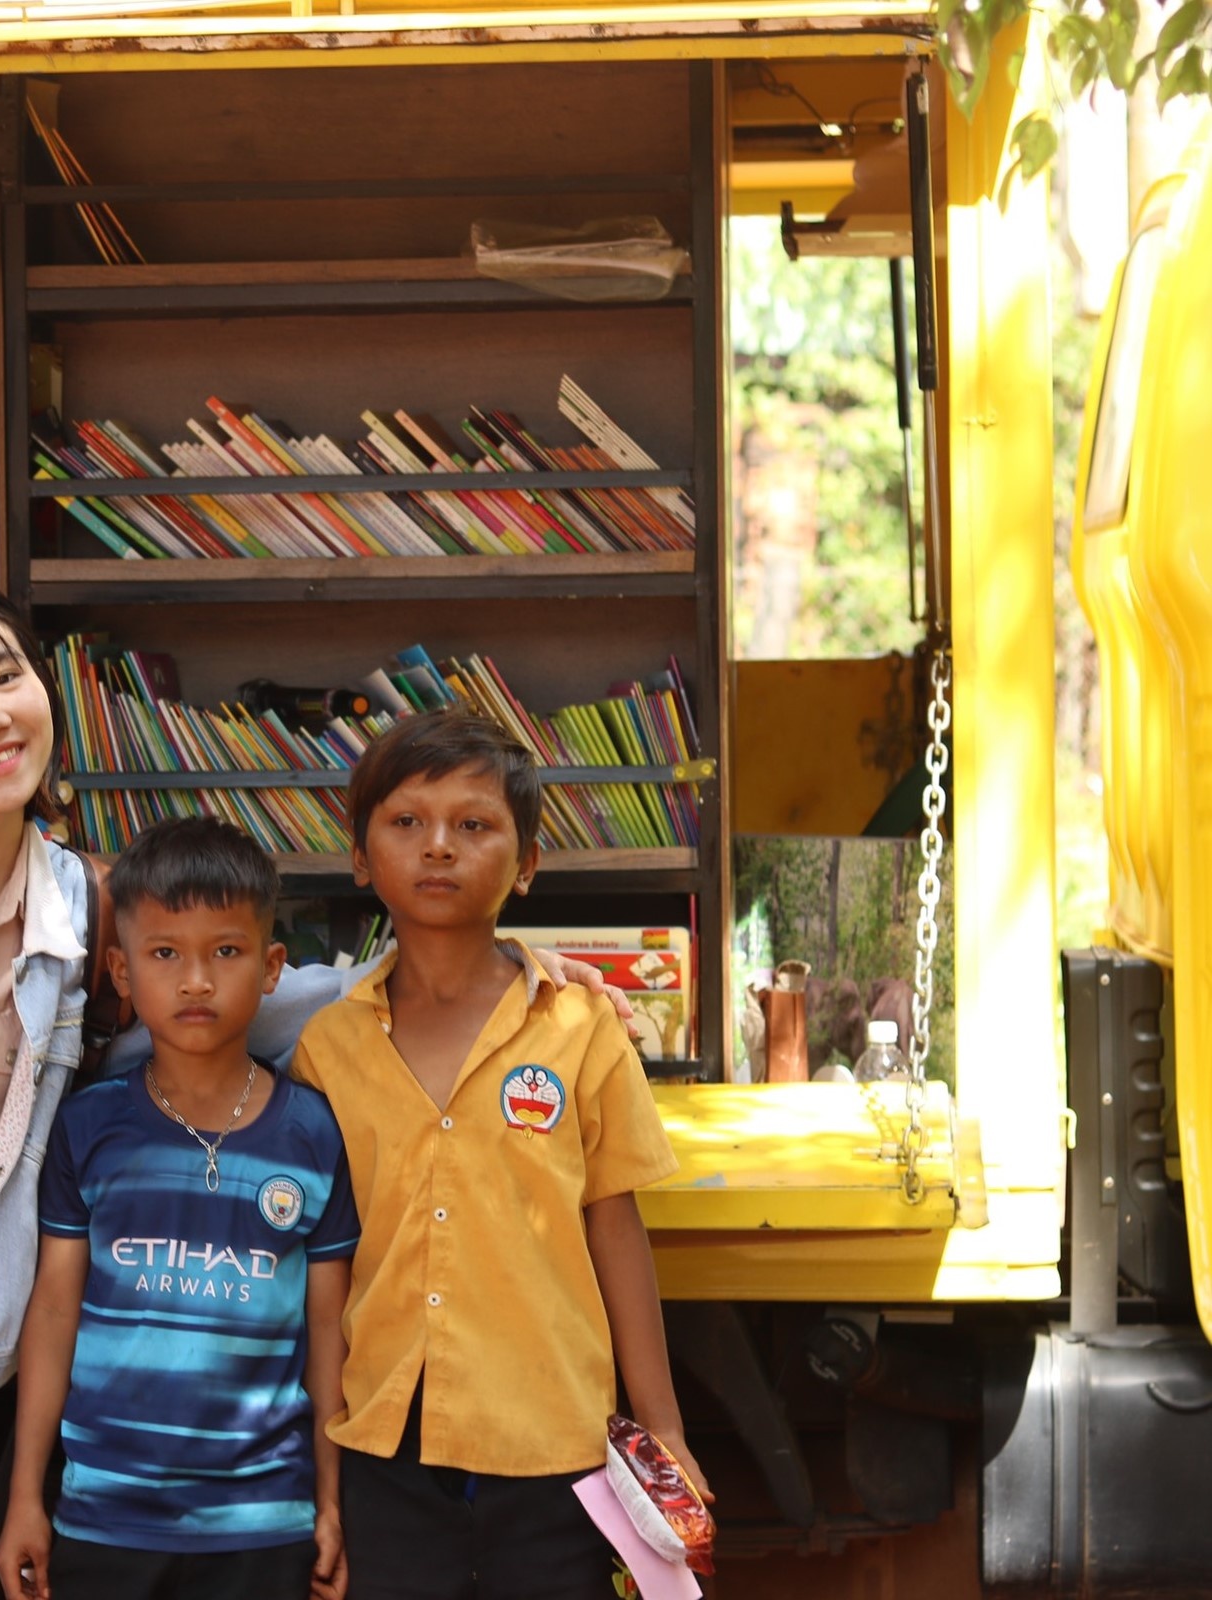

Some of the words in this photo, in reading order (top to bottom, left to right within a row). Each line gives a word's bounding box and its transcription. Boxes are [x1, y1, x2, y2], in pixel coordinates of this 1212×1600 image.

[555, 940, 589, 949] Andrea
[111, 1236, 279, 1280] ETIHAD
[135, 1273, 252, 1303] AIRWAYS
